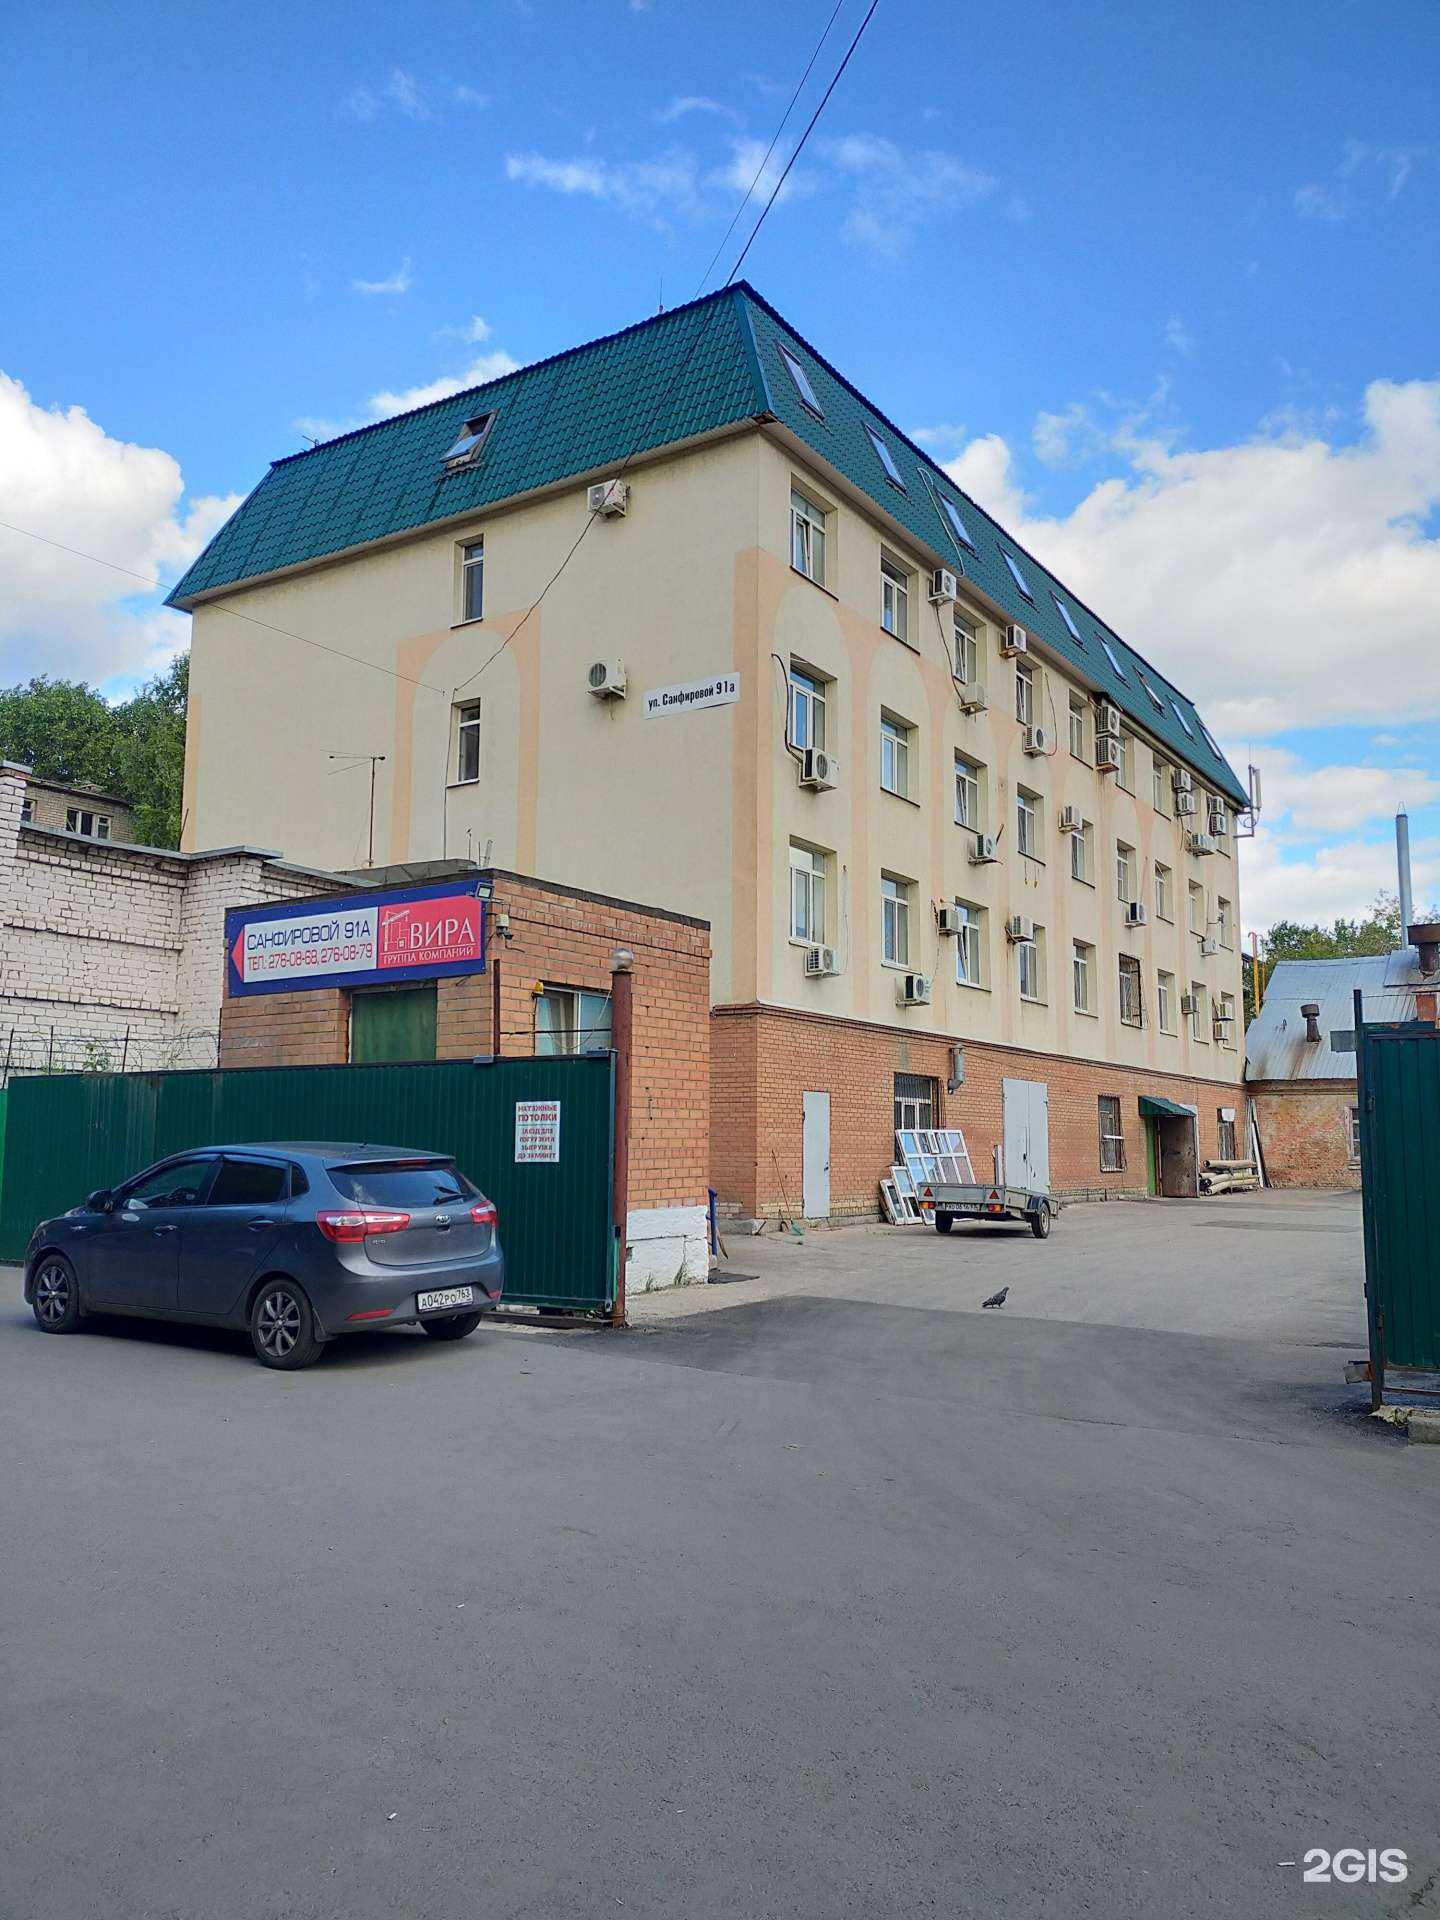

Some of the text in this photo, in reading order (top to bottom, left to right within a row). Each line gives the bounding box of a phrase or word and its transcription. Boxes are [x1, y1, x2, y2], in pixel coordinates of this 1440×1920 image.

[648, 680, 735, 711] ул. Санфировой 91а
[247, 920, 371, 950] САНФИРОВОЙ 91А
[410, 917, 475, 949] ВИРА
[320, 942, 373, 963] 276-08-79
[383, 946, 474, 965] ГРУППА КОМПАНИЙ
[518, 1114, 557, 1122] ПОТОЛКИ
